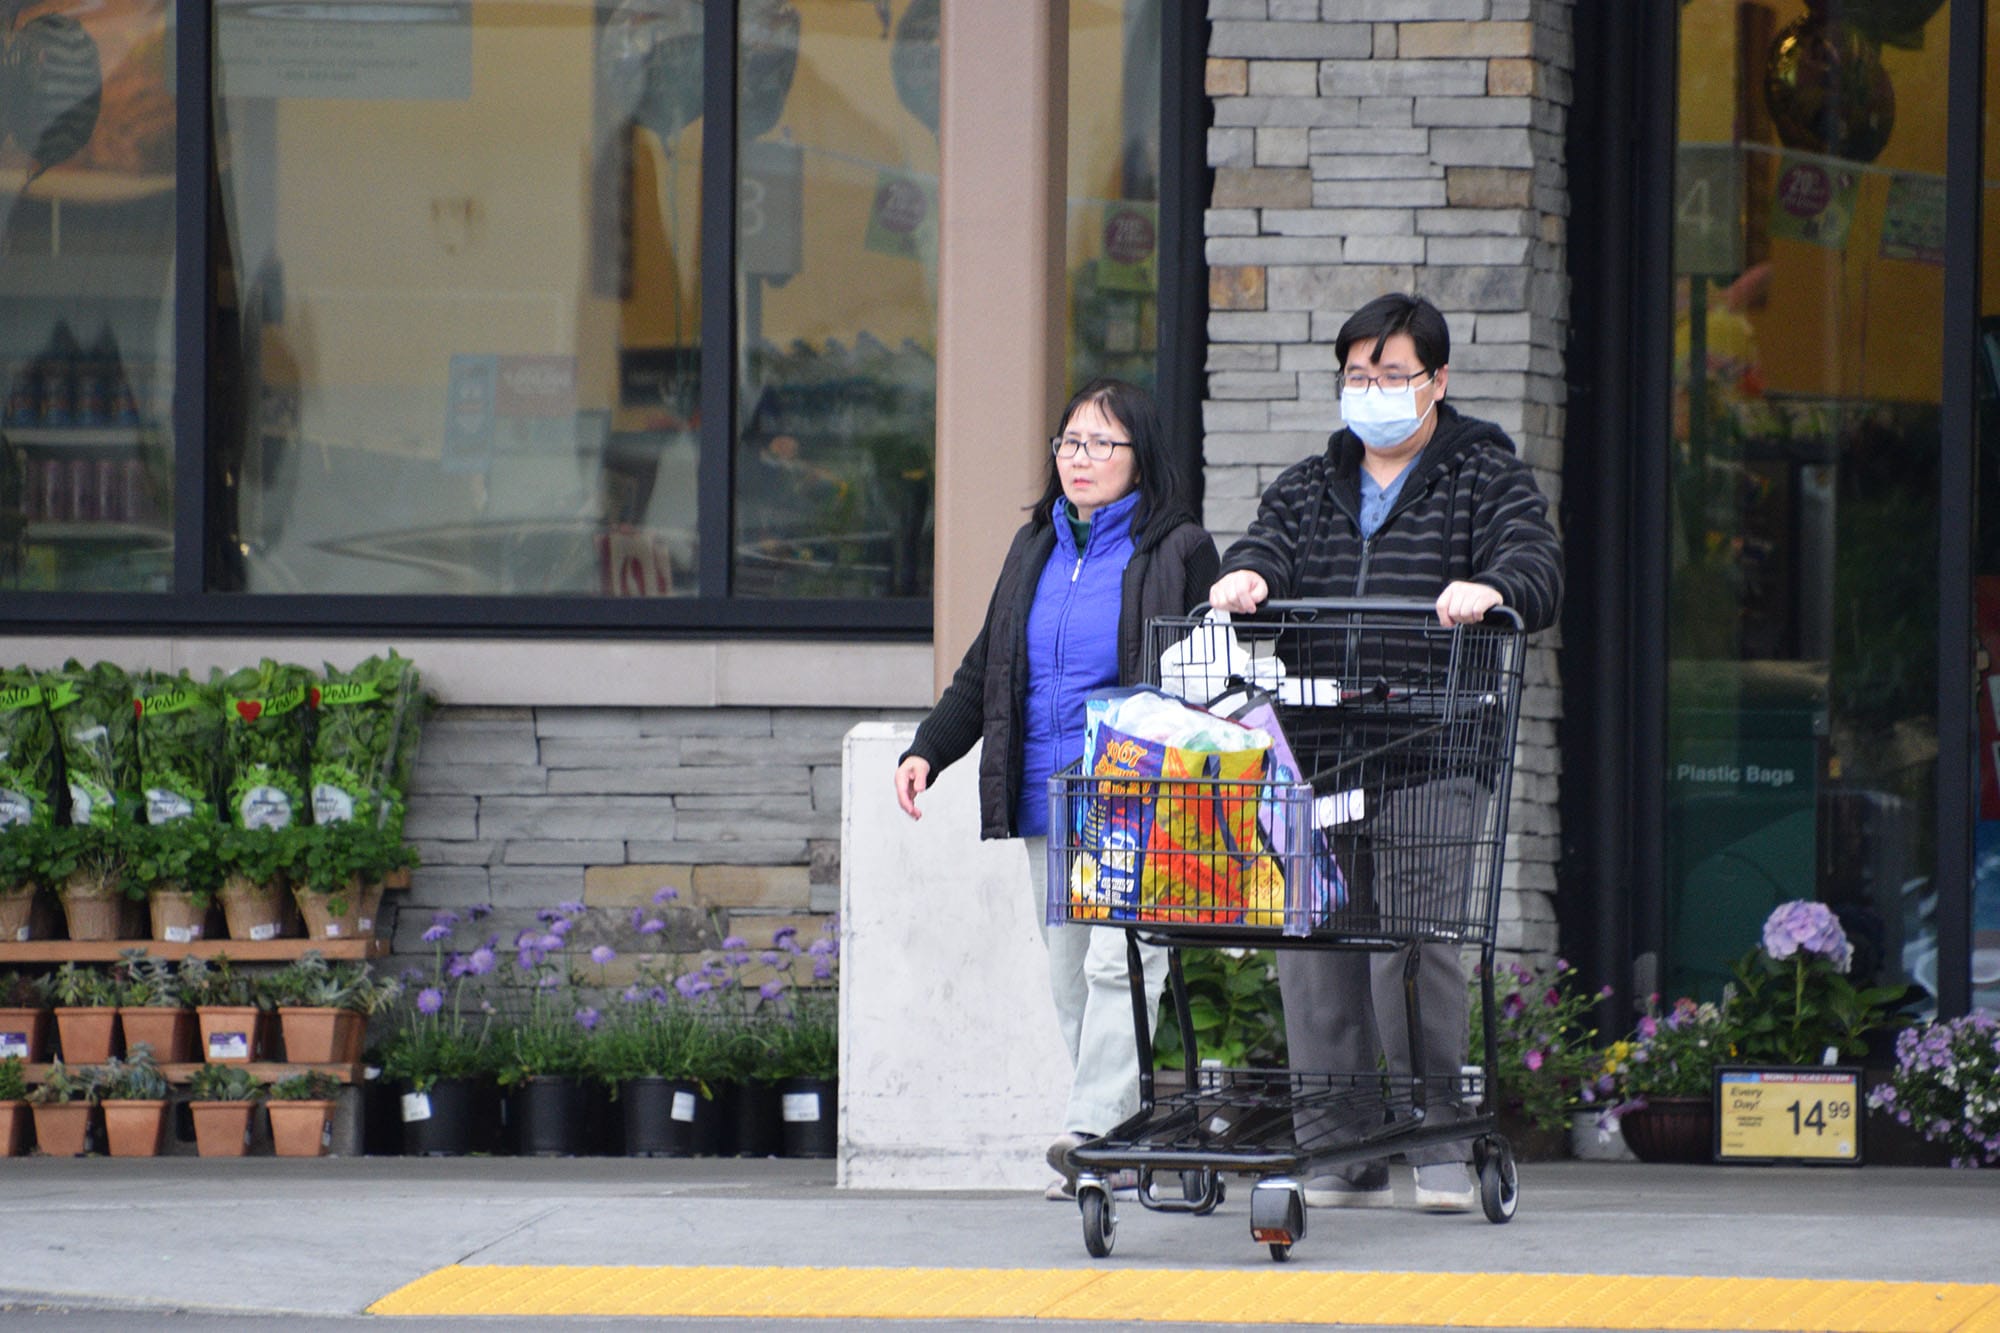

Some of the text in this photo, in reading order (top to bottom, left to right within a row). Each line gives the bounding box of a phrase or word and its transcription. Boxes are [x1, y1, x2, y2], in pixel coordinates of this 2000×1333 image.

[1678, 178, 1712, 235] 4
[0, 686, 30, 704] esto
[142, 688, 187, 711] Pesto
[265, 686, 299, 717] Pesto
[322, 683, 362, 704] Pesto
[1677, 763, 1795, 787] Plastic Bags
[1730, 1086, 1763, 1098] Every
[1733, 1100, 1760, 1112] Day!
